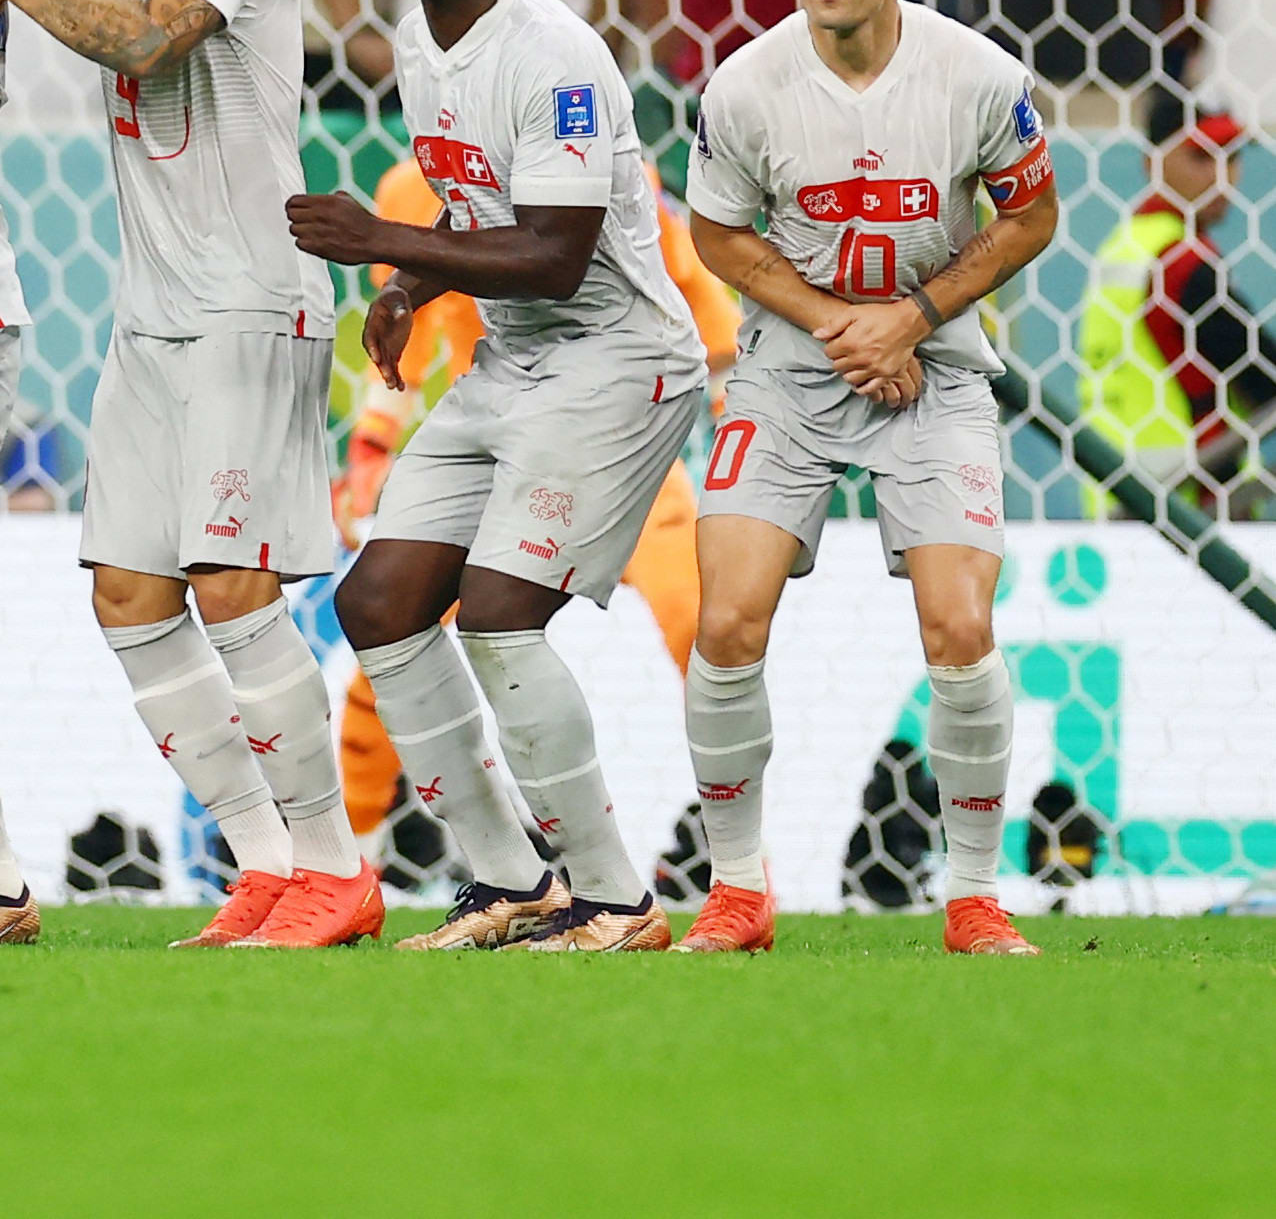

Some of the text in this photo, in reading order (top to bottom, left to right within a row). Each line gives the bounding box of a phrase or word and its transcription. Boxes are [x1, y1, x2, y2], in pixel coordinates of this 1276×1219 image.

[832, 226, 897, 298] 10
[704, 420, 757, 491] 0
[965, 508, 994, 528] PUMA
[205, 523, 238, 539] PUMA
[518, 539, 554, 561] PUMA
